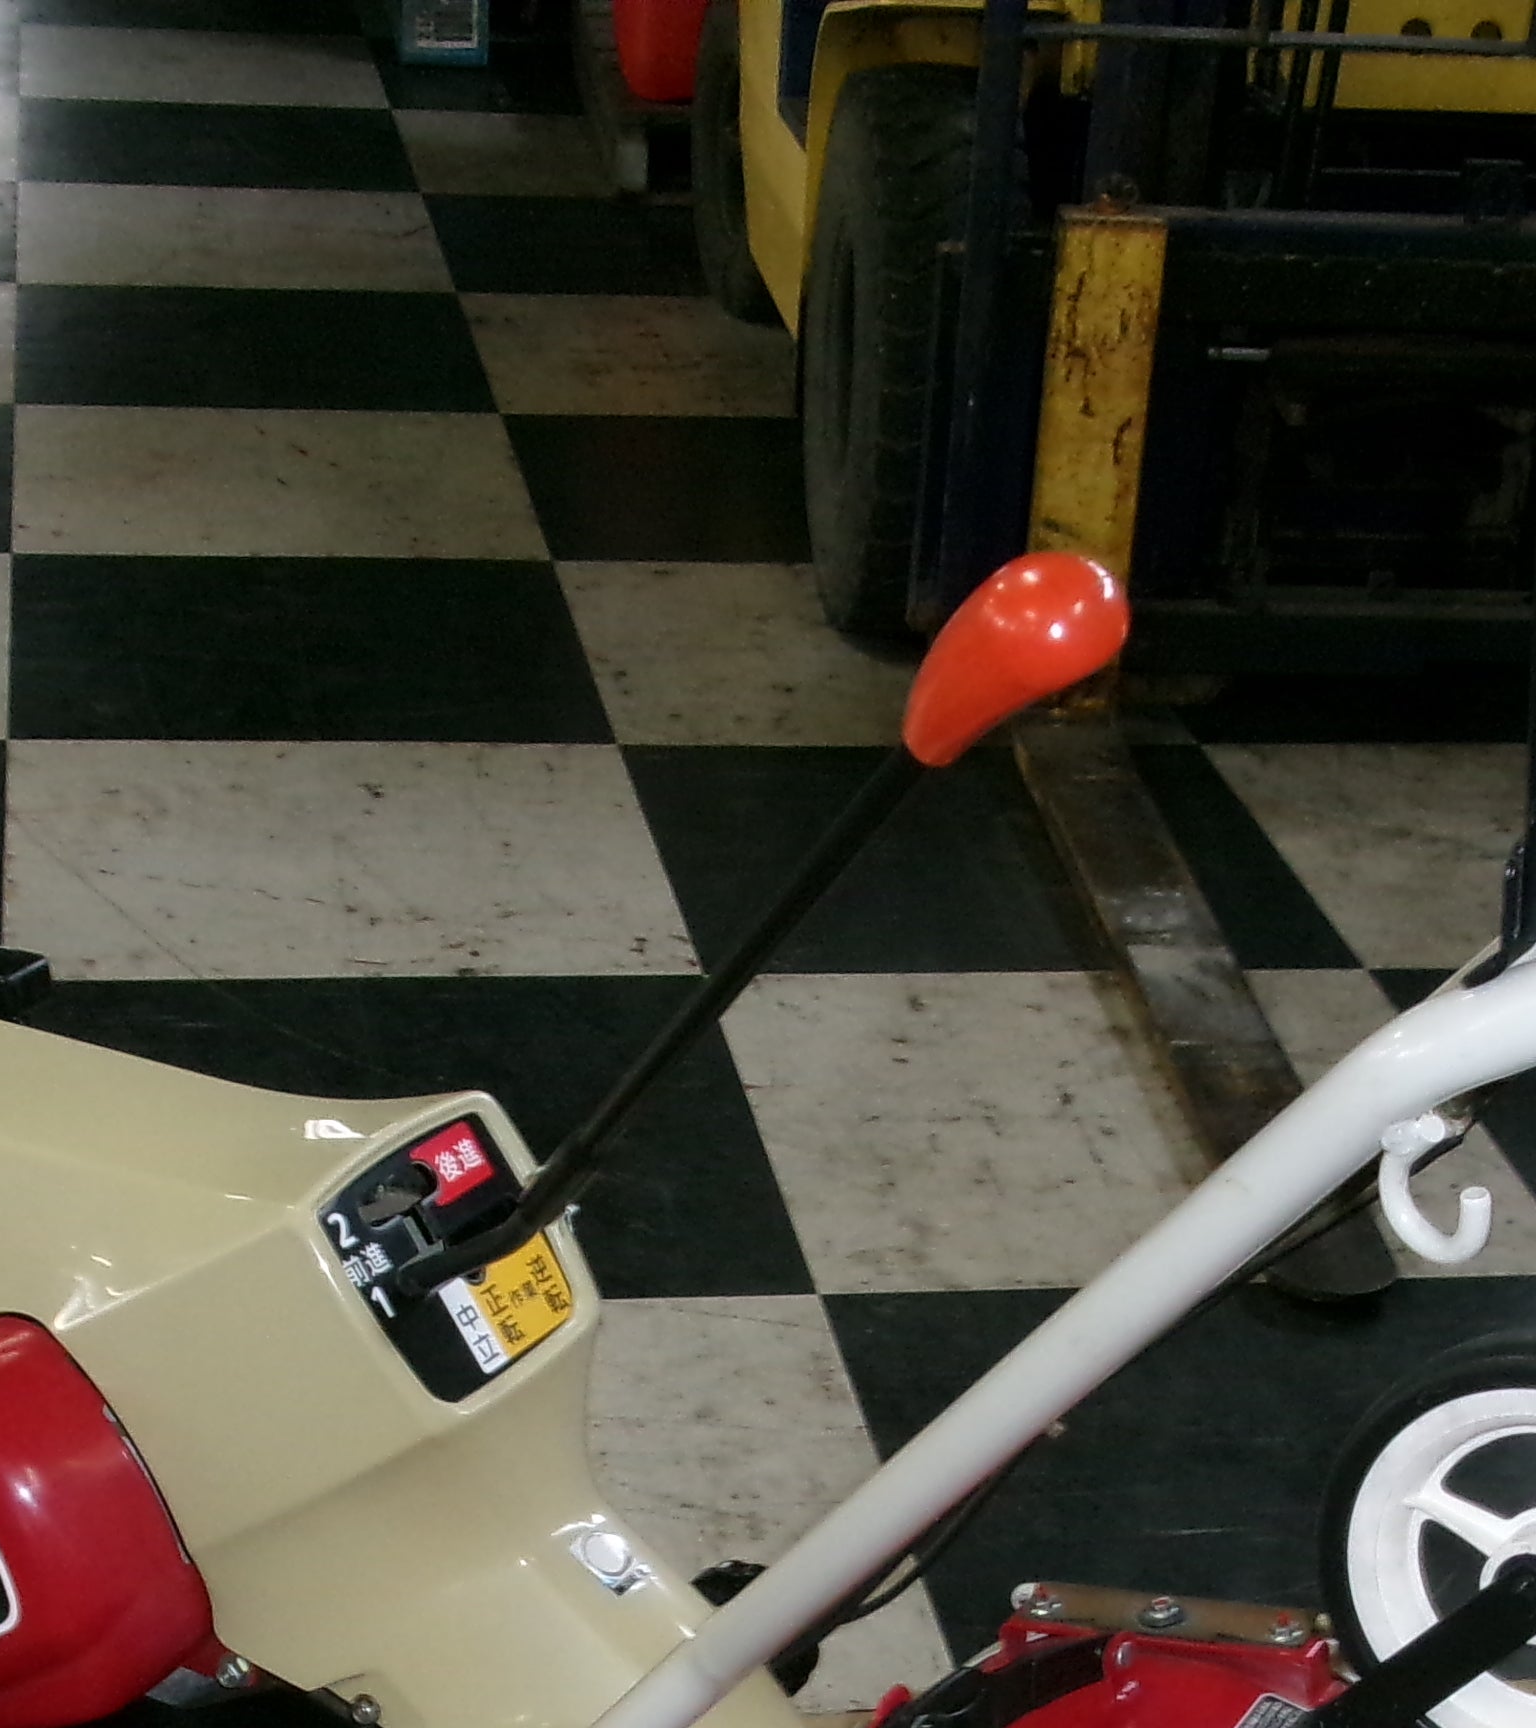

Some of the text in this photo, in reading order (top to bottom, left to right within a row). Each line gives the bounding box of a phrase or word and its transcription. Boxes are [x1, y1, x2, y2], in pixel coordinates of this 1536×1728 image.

[434, 1137, 485, 1183] 後進
[326, 1211, 362, 1249] 2
[341, 1241, 395, 1288] 前進
[369, 1285, 397, 1319] 1
[479, 1283, 526, 1345] 正転
[455, 1304, 500, 1365] 中立
